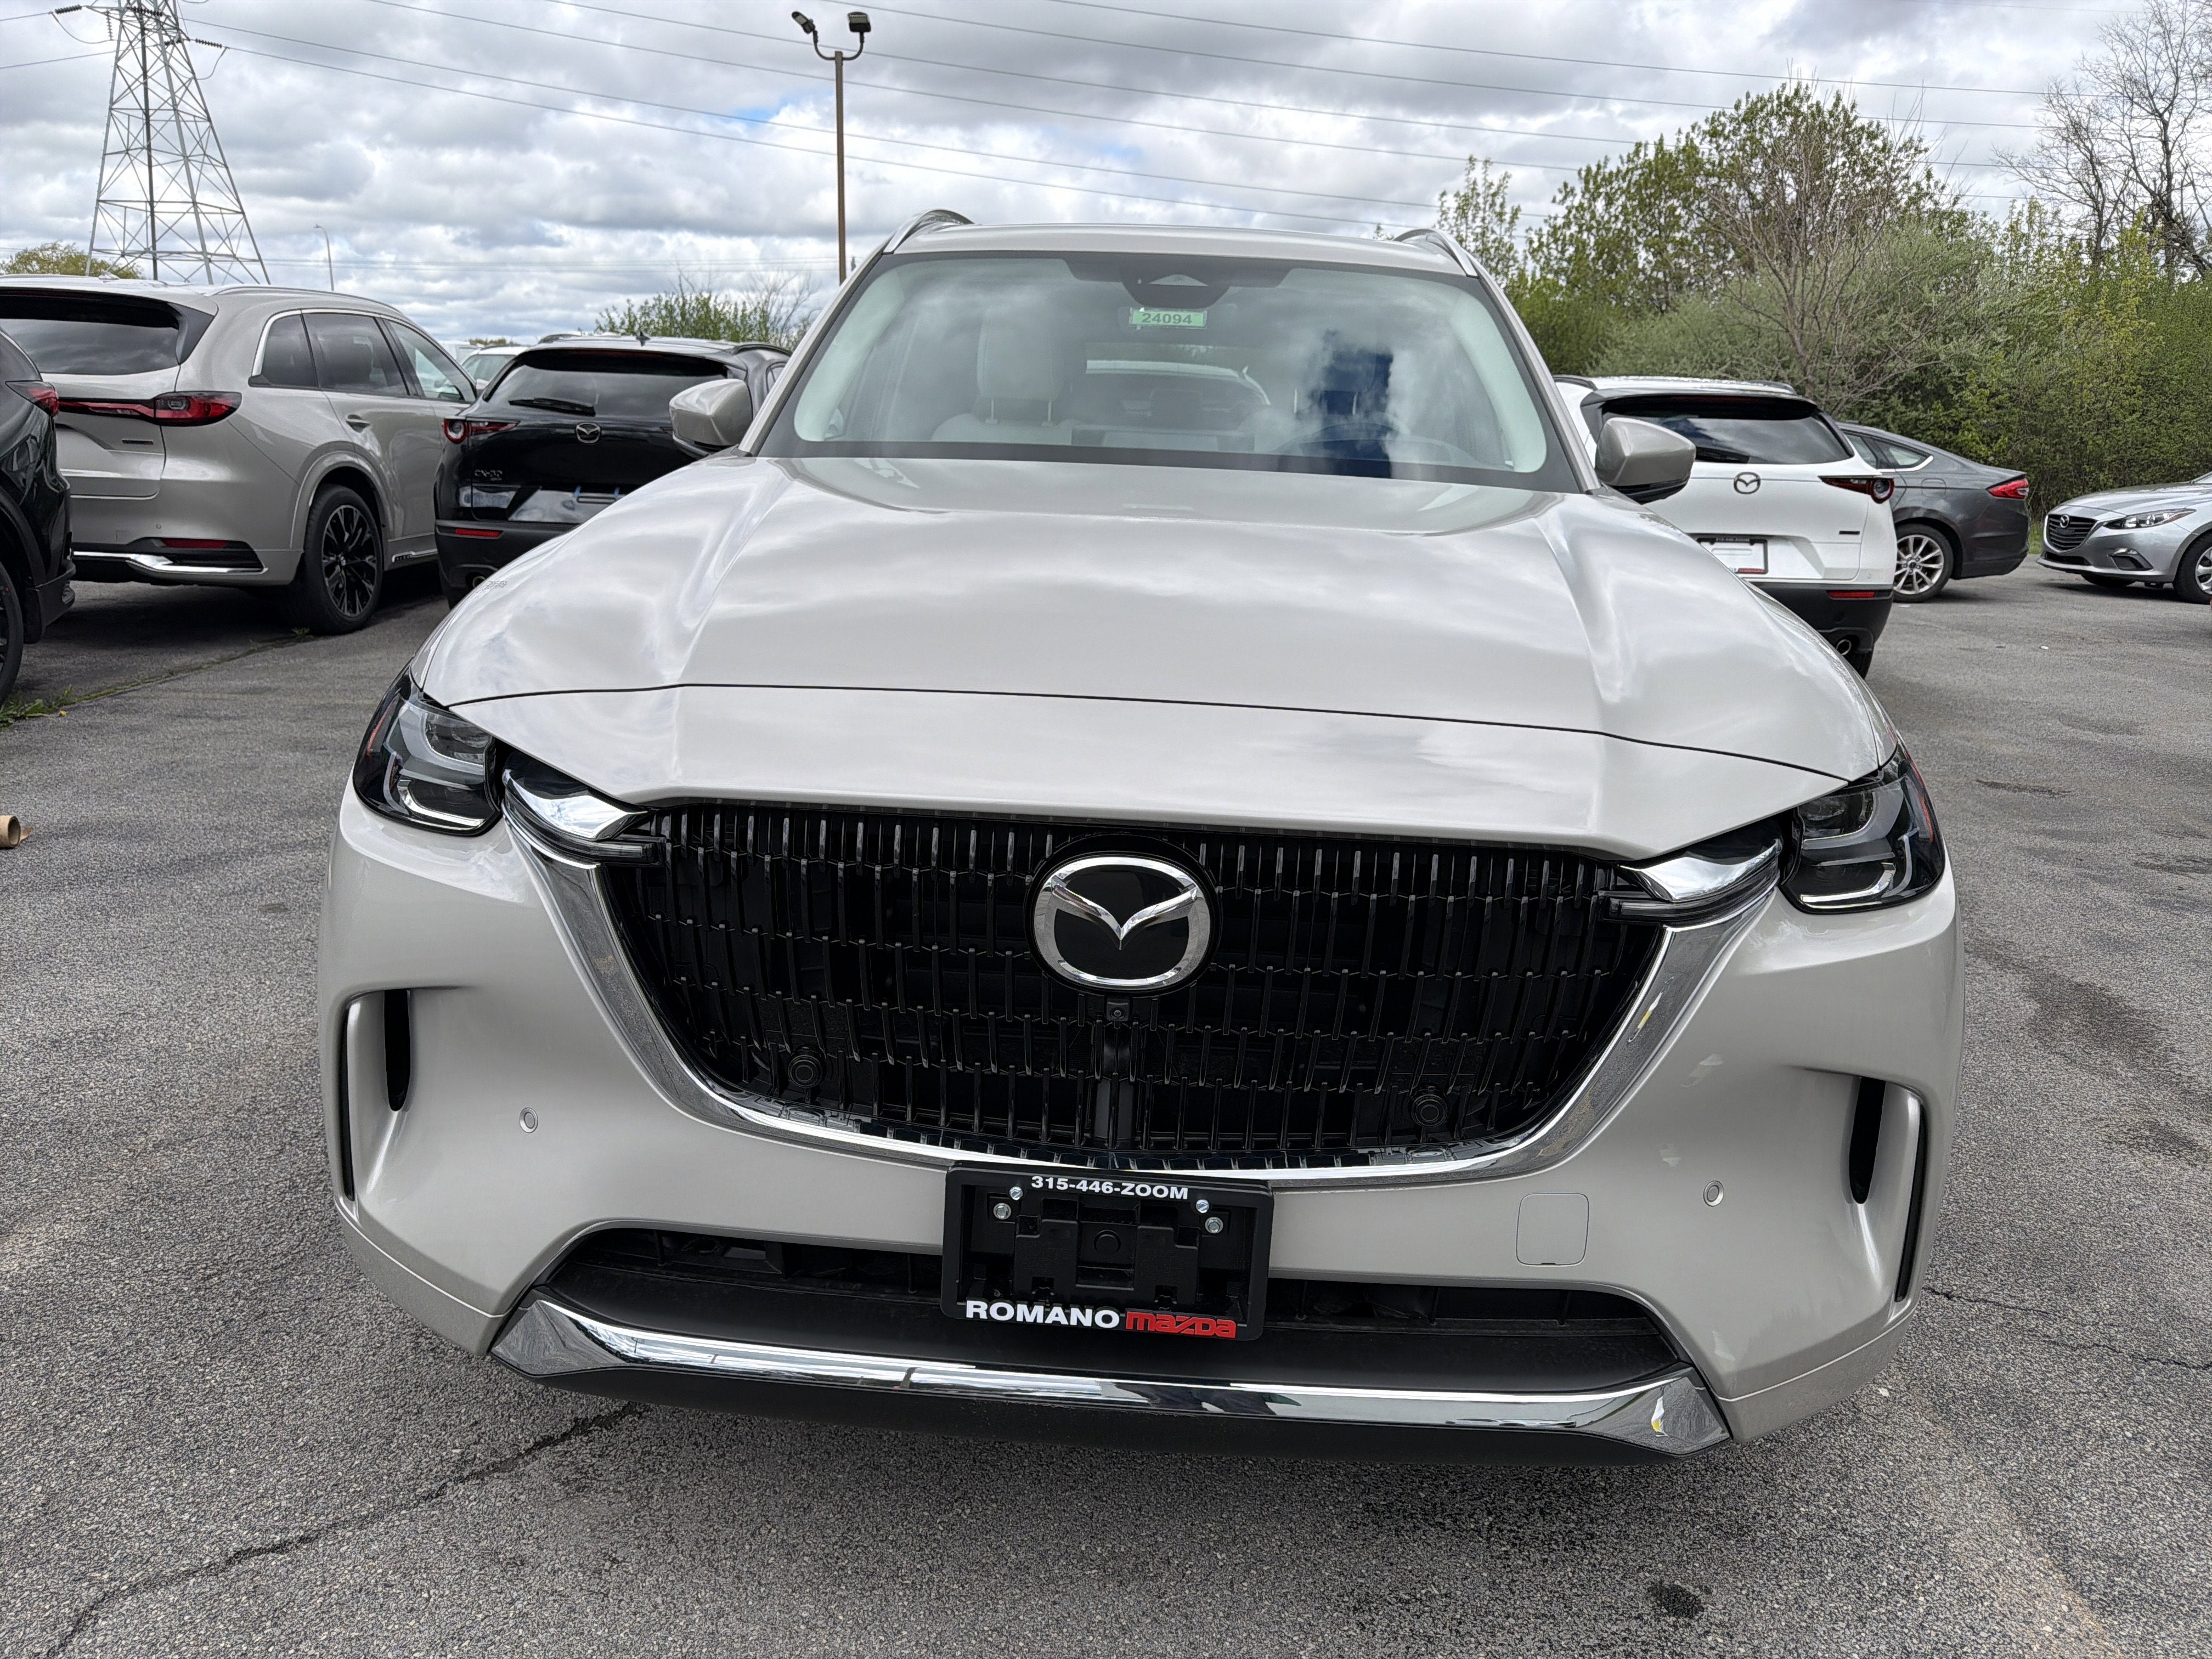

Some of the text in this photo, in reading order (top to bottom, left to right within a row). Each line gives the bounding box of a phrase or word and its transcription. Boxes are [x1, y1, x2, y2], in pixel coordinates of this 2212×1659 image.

[1142, 313, 1192, 325] 24094
[1031, 1176, 1189, 1200] 315-446-ZOOM
[966, 1300, 1120, 1329] ROMANO
